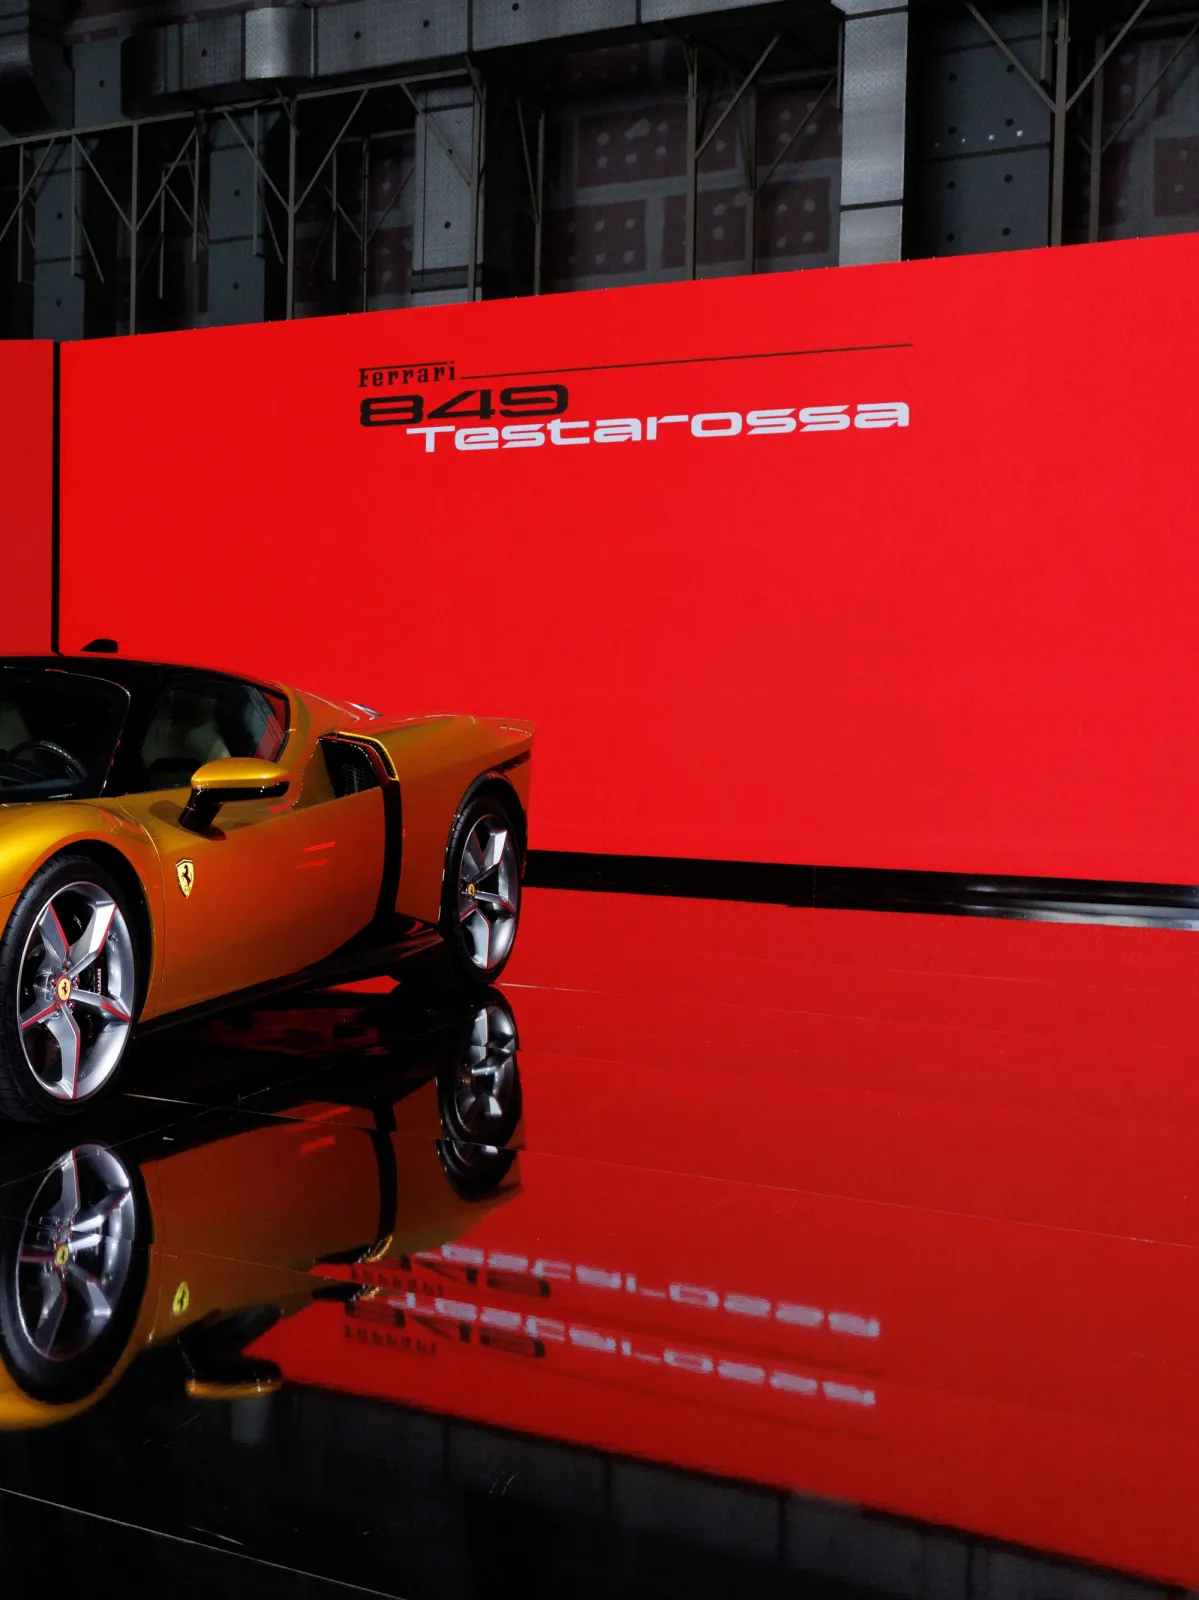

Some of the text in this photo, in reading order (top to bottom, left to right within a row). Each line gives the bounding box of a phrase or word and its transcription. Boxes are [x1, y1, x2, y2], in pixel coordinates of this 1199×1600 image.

[358, 361, 456, 388] Ferrari
[359, 384, 569, 428] 849
[406, 401, 910, 453] Testarossa
